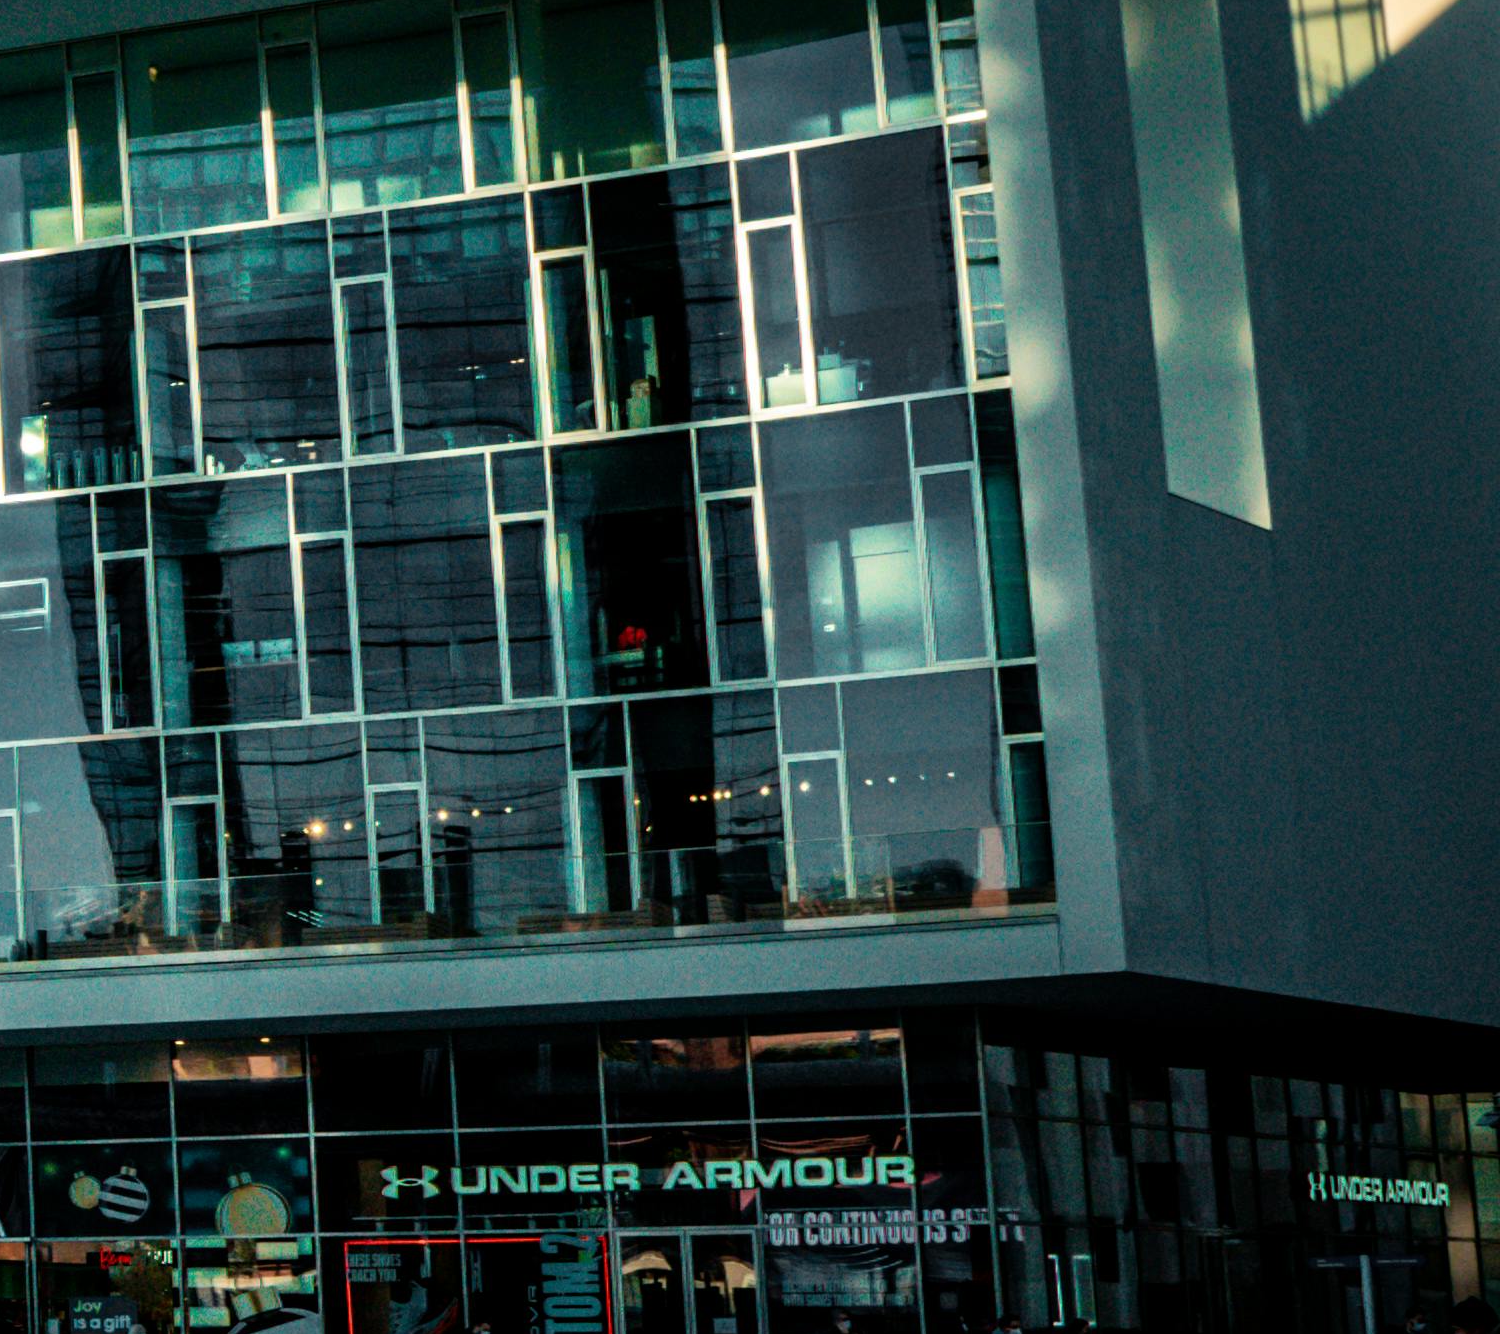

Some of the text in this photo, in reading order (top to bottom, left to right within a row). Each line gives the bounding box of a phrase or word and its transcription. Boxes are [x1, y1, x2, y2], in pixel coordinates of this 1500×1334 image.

[451, 1156, 916, 1195] UNDER ARMOUR
[1329, 1174, 1451, 1208] UNDER ARMOUR
[763, 1210, 800, 1247] OR
[73, 1299, 103, 1315] Joy
[73, 1318, 88, 1330] is
[90, 1318, 102, 1330] a
